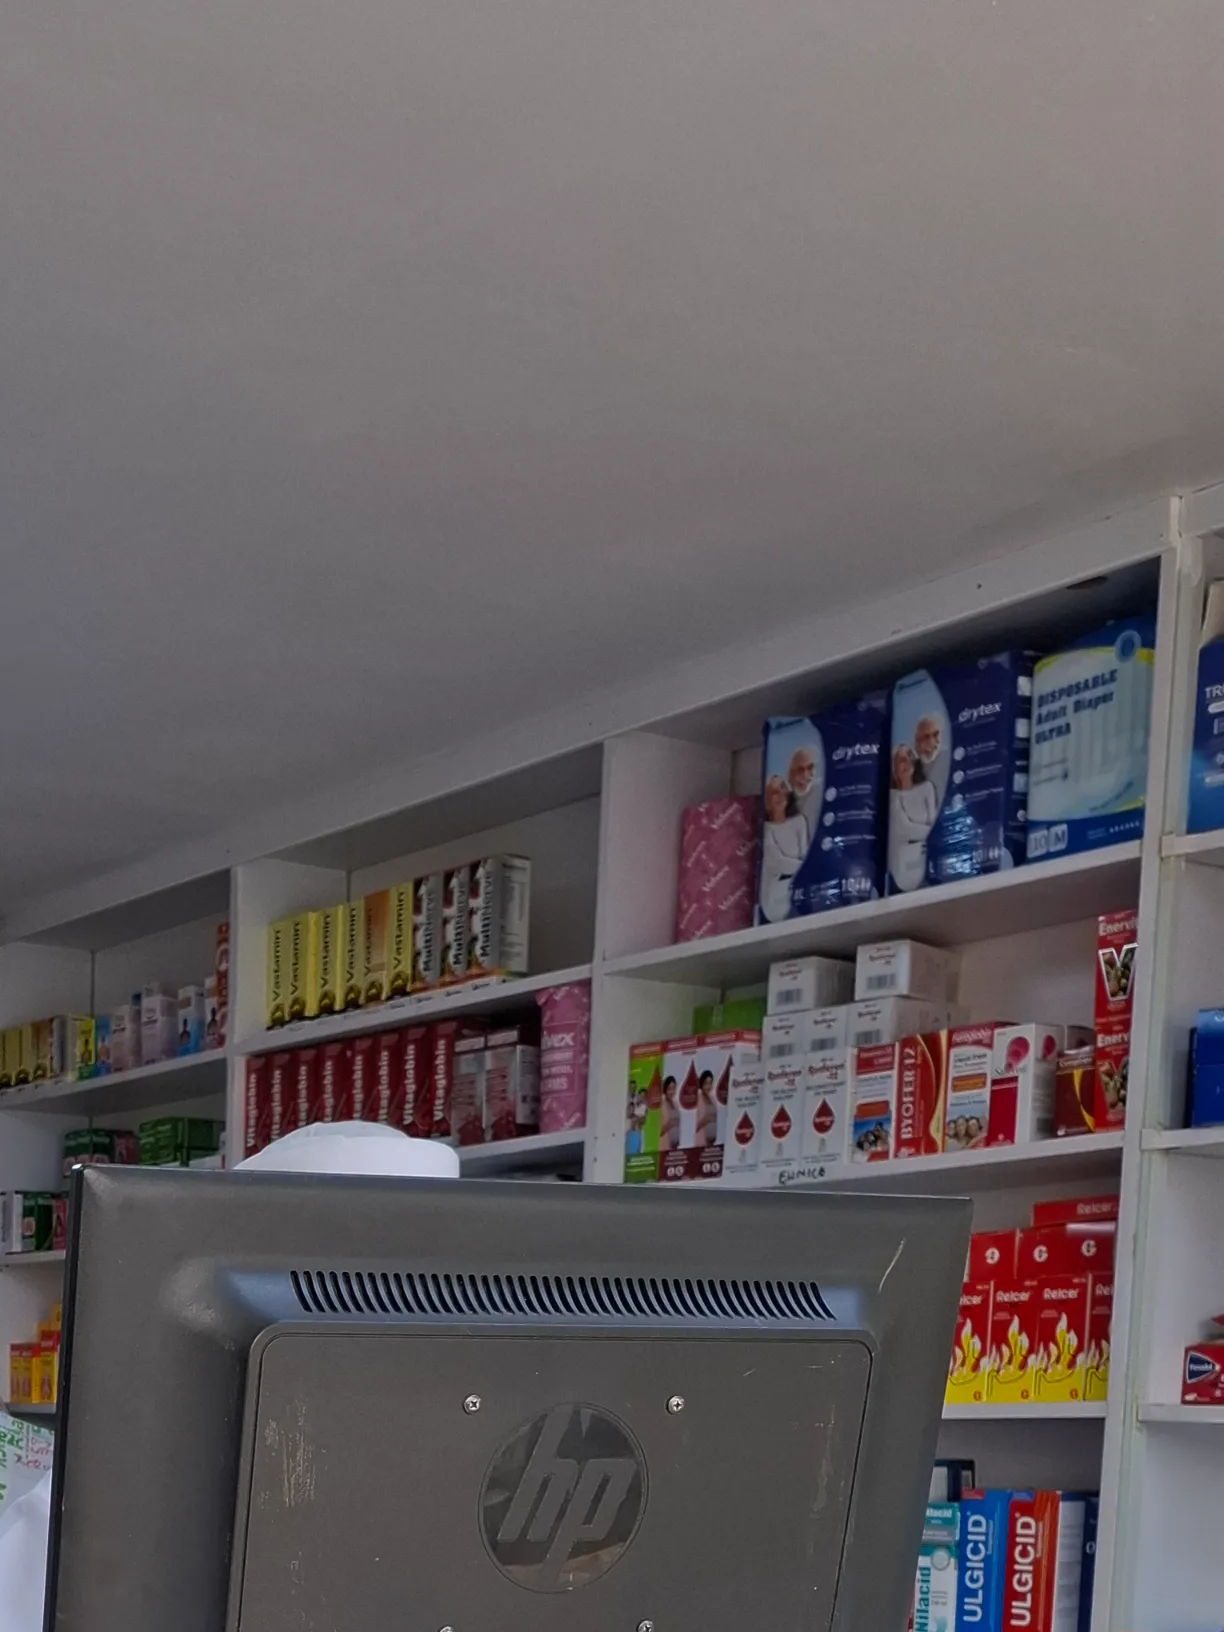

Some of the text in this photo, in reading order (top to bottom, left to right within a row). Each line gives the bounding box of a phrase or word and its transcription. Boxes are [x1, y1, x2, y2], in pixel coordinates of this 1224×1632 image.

[290, 920, 302, 995] Vastamin
[320, 914, 331, 989] Vastamin
[346, 906, 357, 983] Vastamin
[393, 890, 405, 969] Vastamin
[246, 1072, 258, 1147] Vitaglobin
[402, 1043, 416, 1125] Vitaglobin
[433, 1038, 447, 1121] Vitaglobin
[996, 1290, 1032, 1304] Relcer
[1043, 1287, 1080, 1301] Relcer
[496, 1402, 637, 1593] hp
[963, 1513, 988, 1624] ULGICID
[1010, 1515, 1037, 1627] ULGICID
